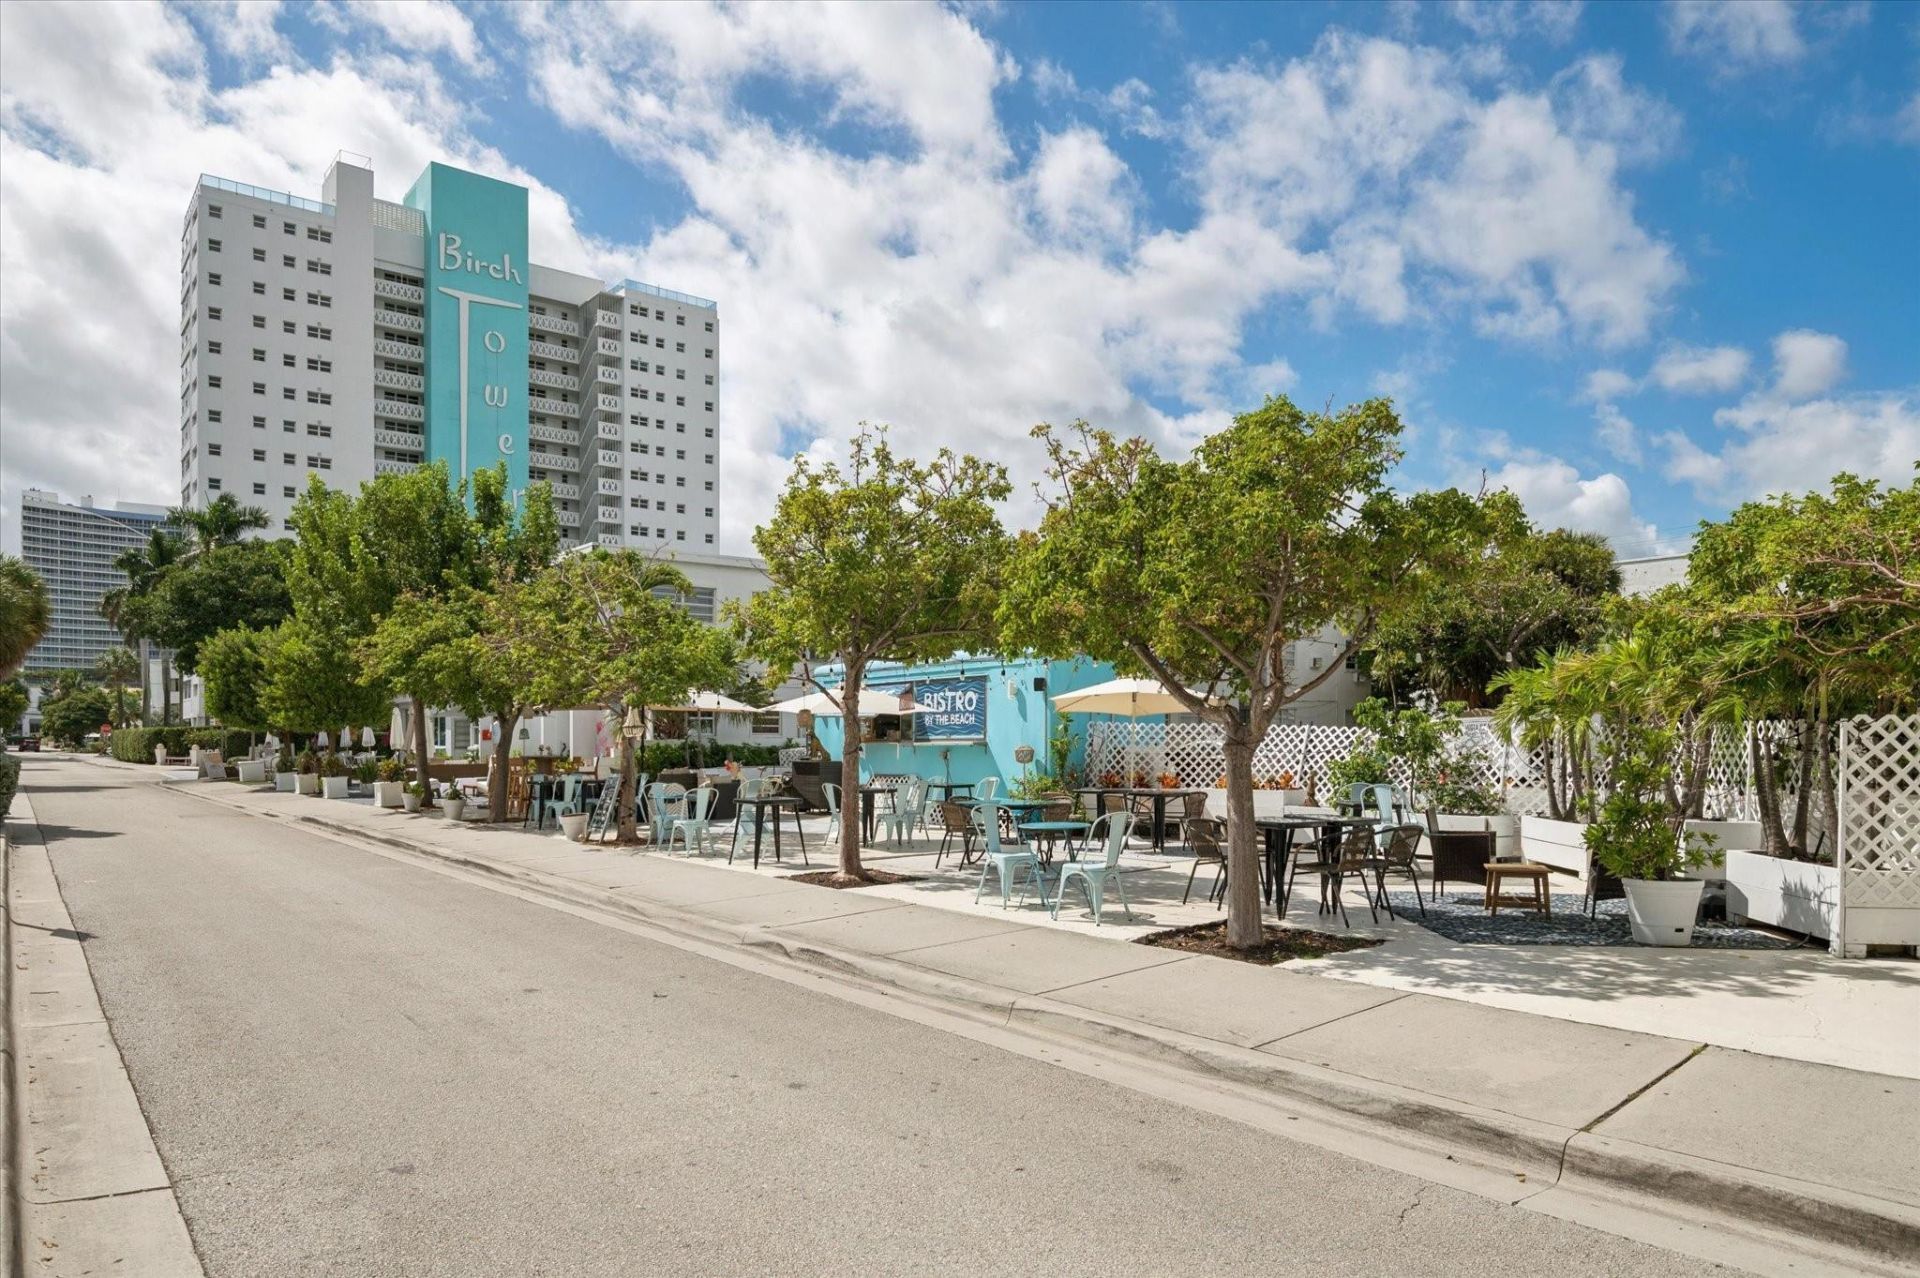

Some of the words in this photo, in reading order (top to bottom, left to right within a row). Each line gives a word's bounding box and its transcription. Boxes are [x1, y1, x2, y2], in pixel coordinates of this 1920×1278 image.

[439, 232, 522, 285] Birch
[924, 690, 977, 712] BISTRO
[924, 714, 933, 726] BY
[935, 714, 949, 725] THE
[950, 713, 975, 724] BEACH
